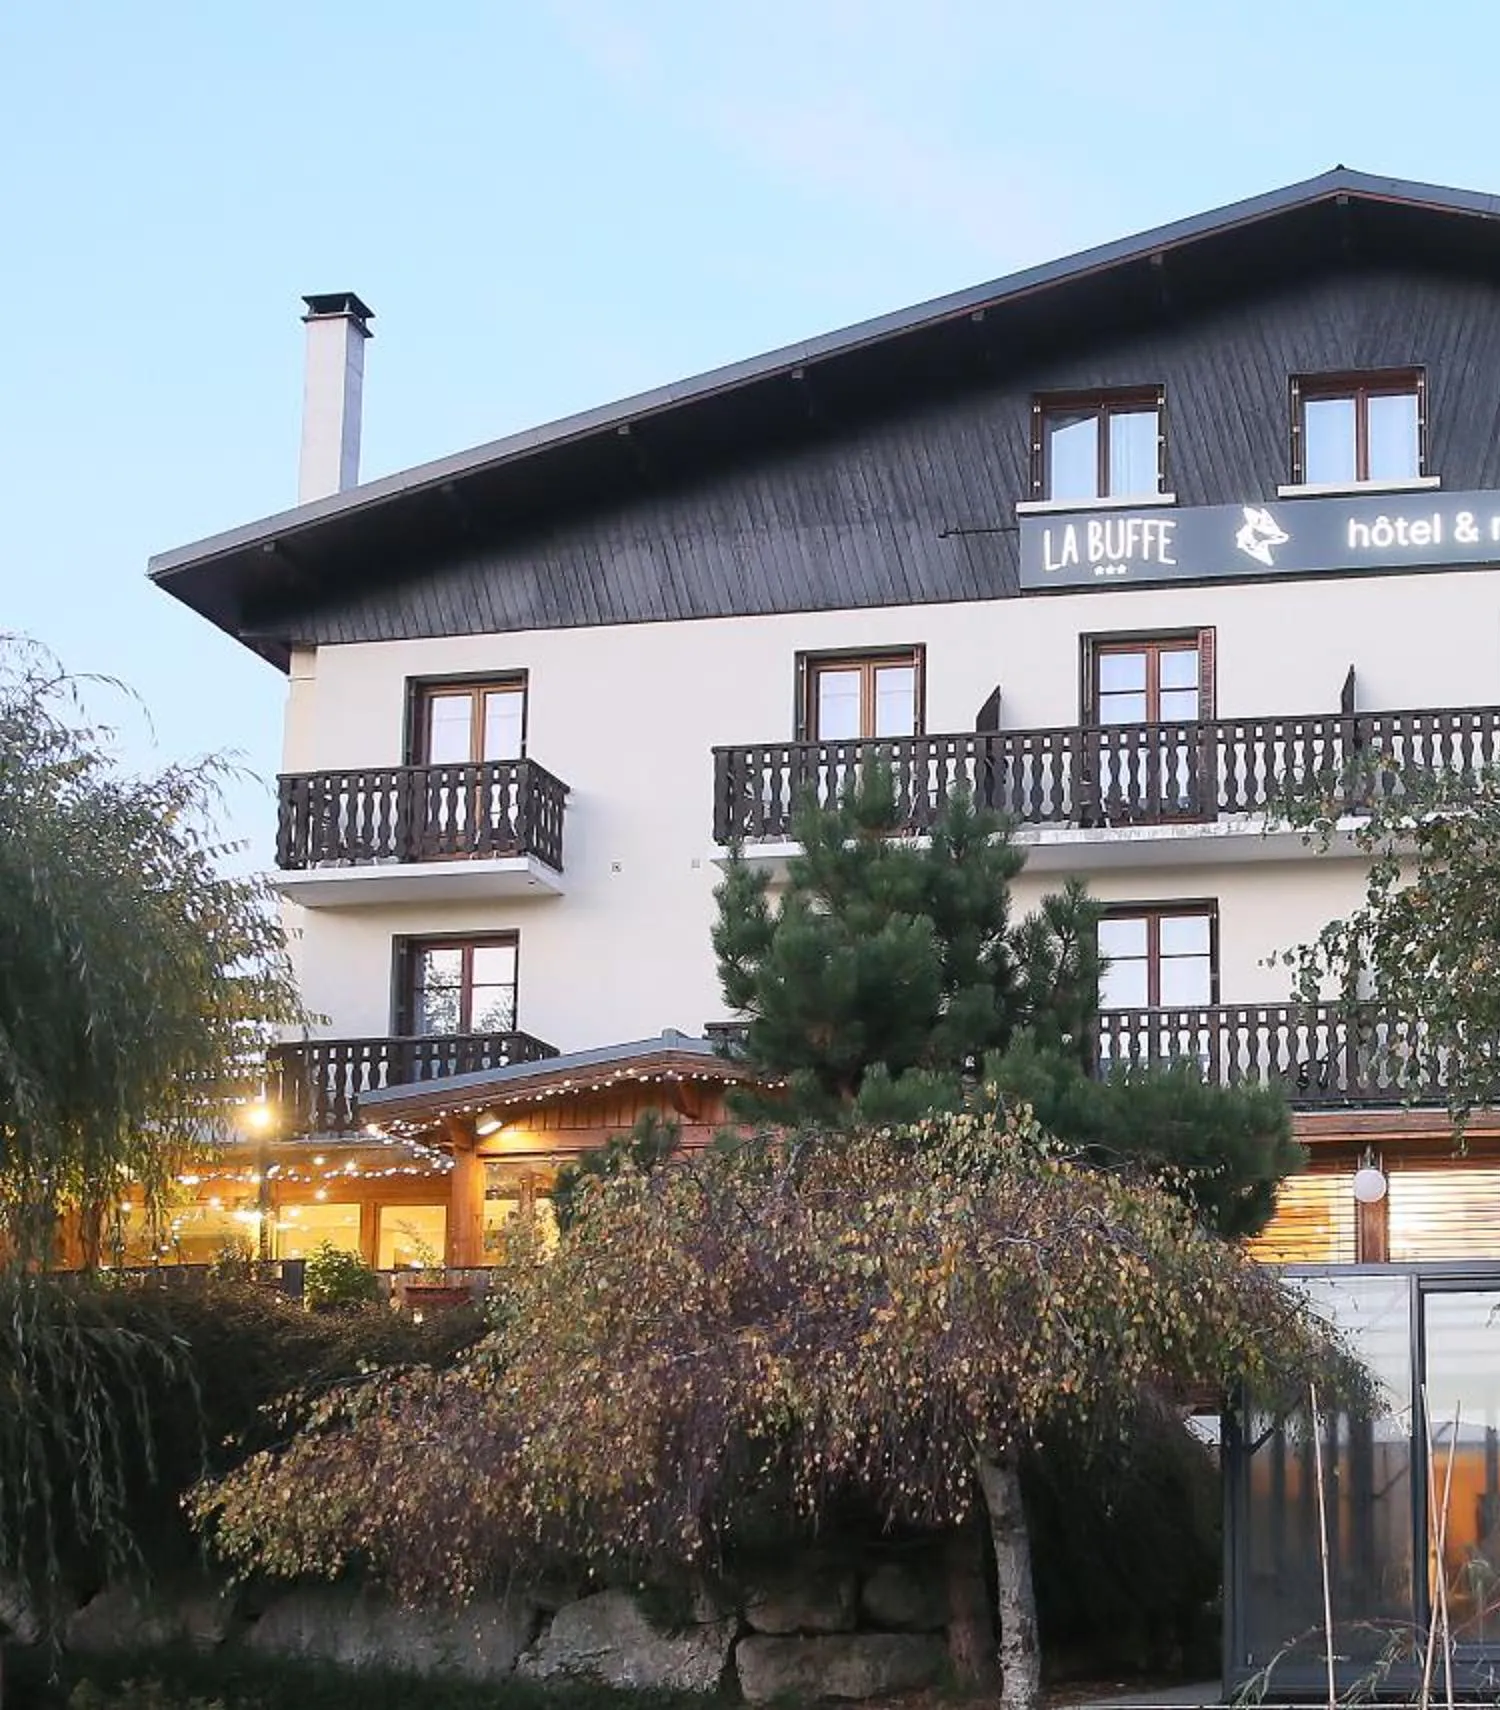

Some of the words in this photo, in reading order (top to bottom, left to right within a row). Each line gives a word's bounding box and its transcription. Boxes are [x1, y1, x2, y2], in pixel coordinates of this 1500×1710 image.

[1043, 524, 1079, 571] LA
[1087, 518, 1177, 565] BUFFE
[1347, 512, 1442, 549] hôtel
[1454, 511, 1480, 543] &
